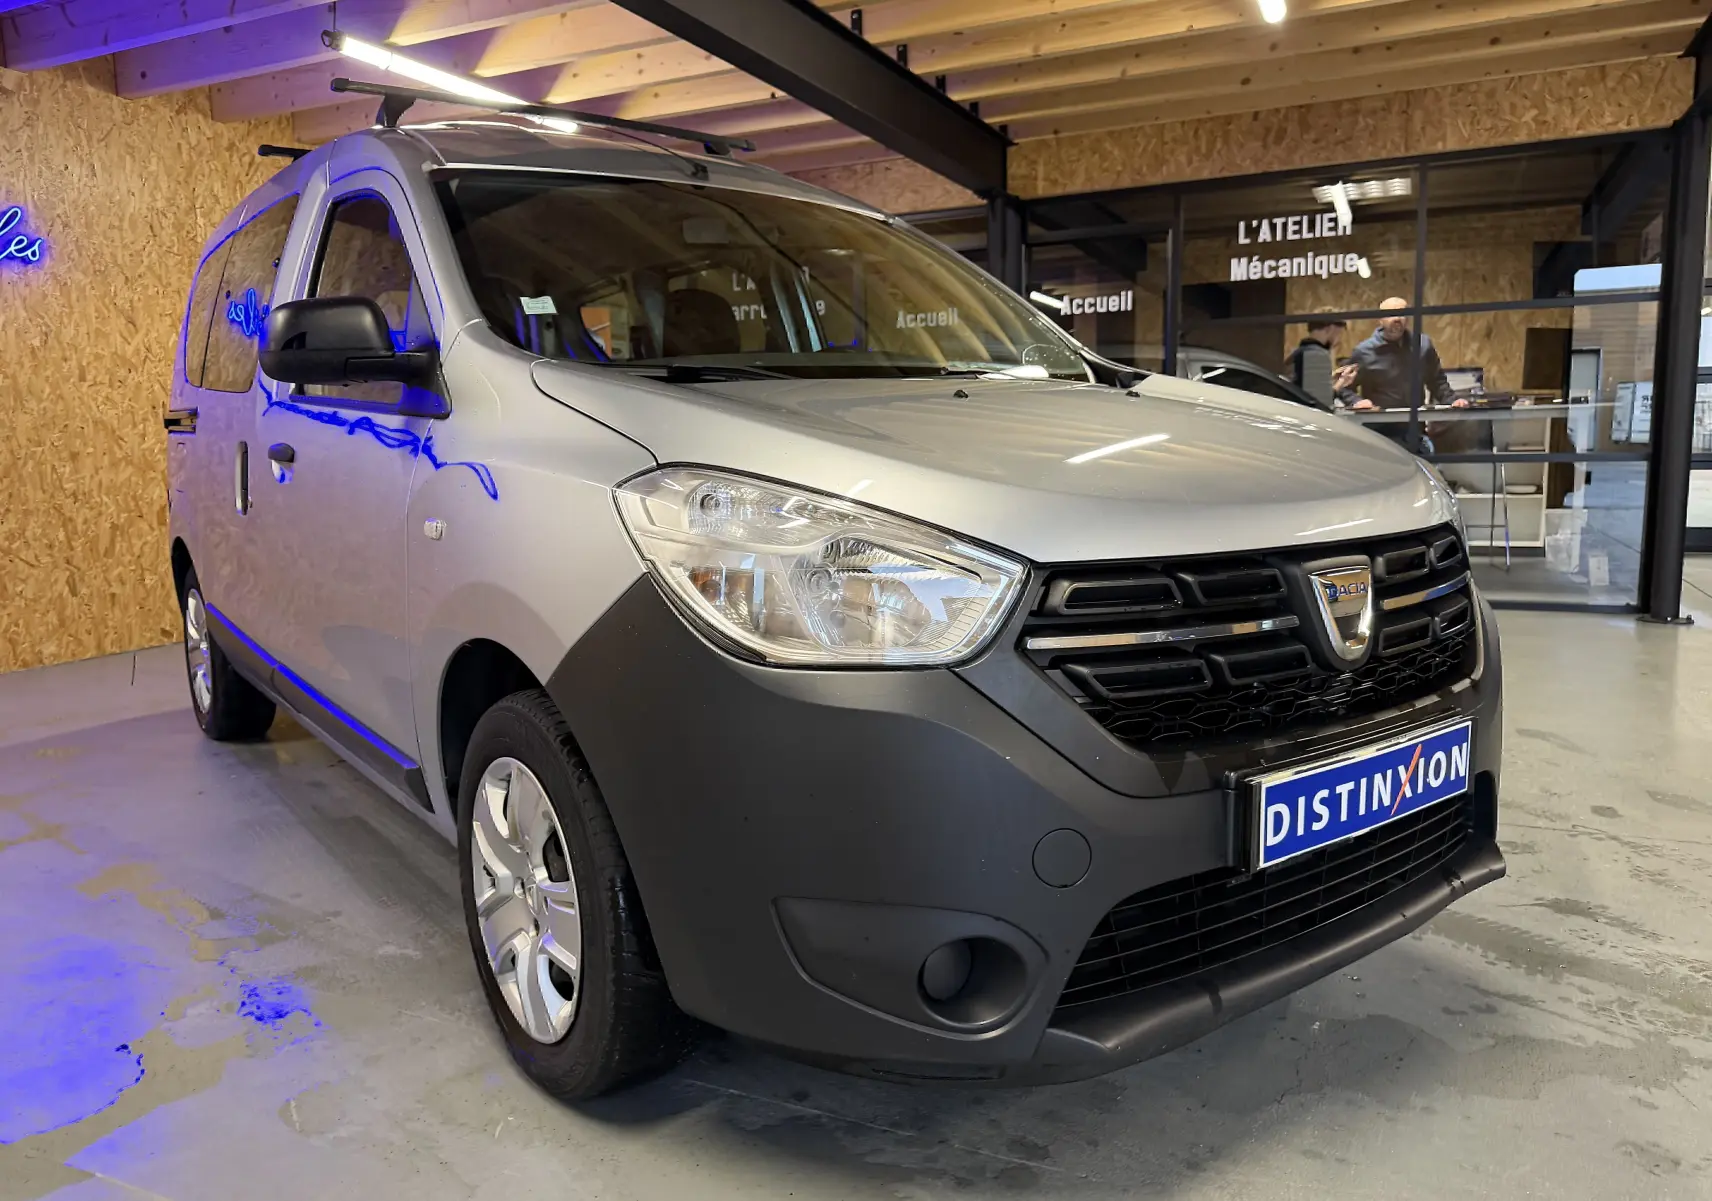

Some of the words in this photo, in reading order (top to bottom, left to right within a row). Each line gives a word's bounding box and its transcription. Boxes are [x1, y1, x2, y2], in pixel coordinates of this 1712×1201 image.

[1230, 251, 1359, 281] Mécanique
[1060, 289, 1133, 316] Accueil
[896, 307, 958, 329] Accueil
[1326, 581, 1367, 600] DACIA
[1266, 742, 1468, 847] DISTINXION
